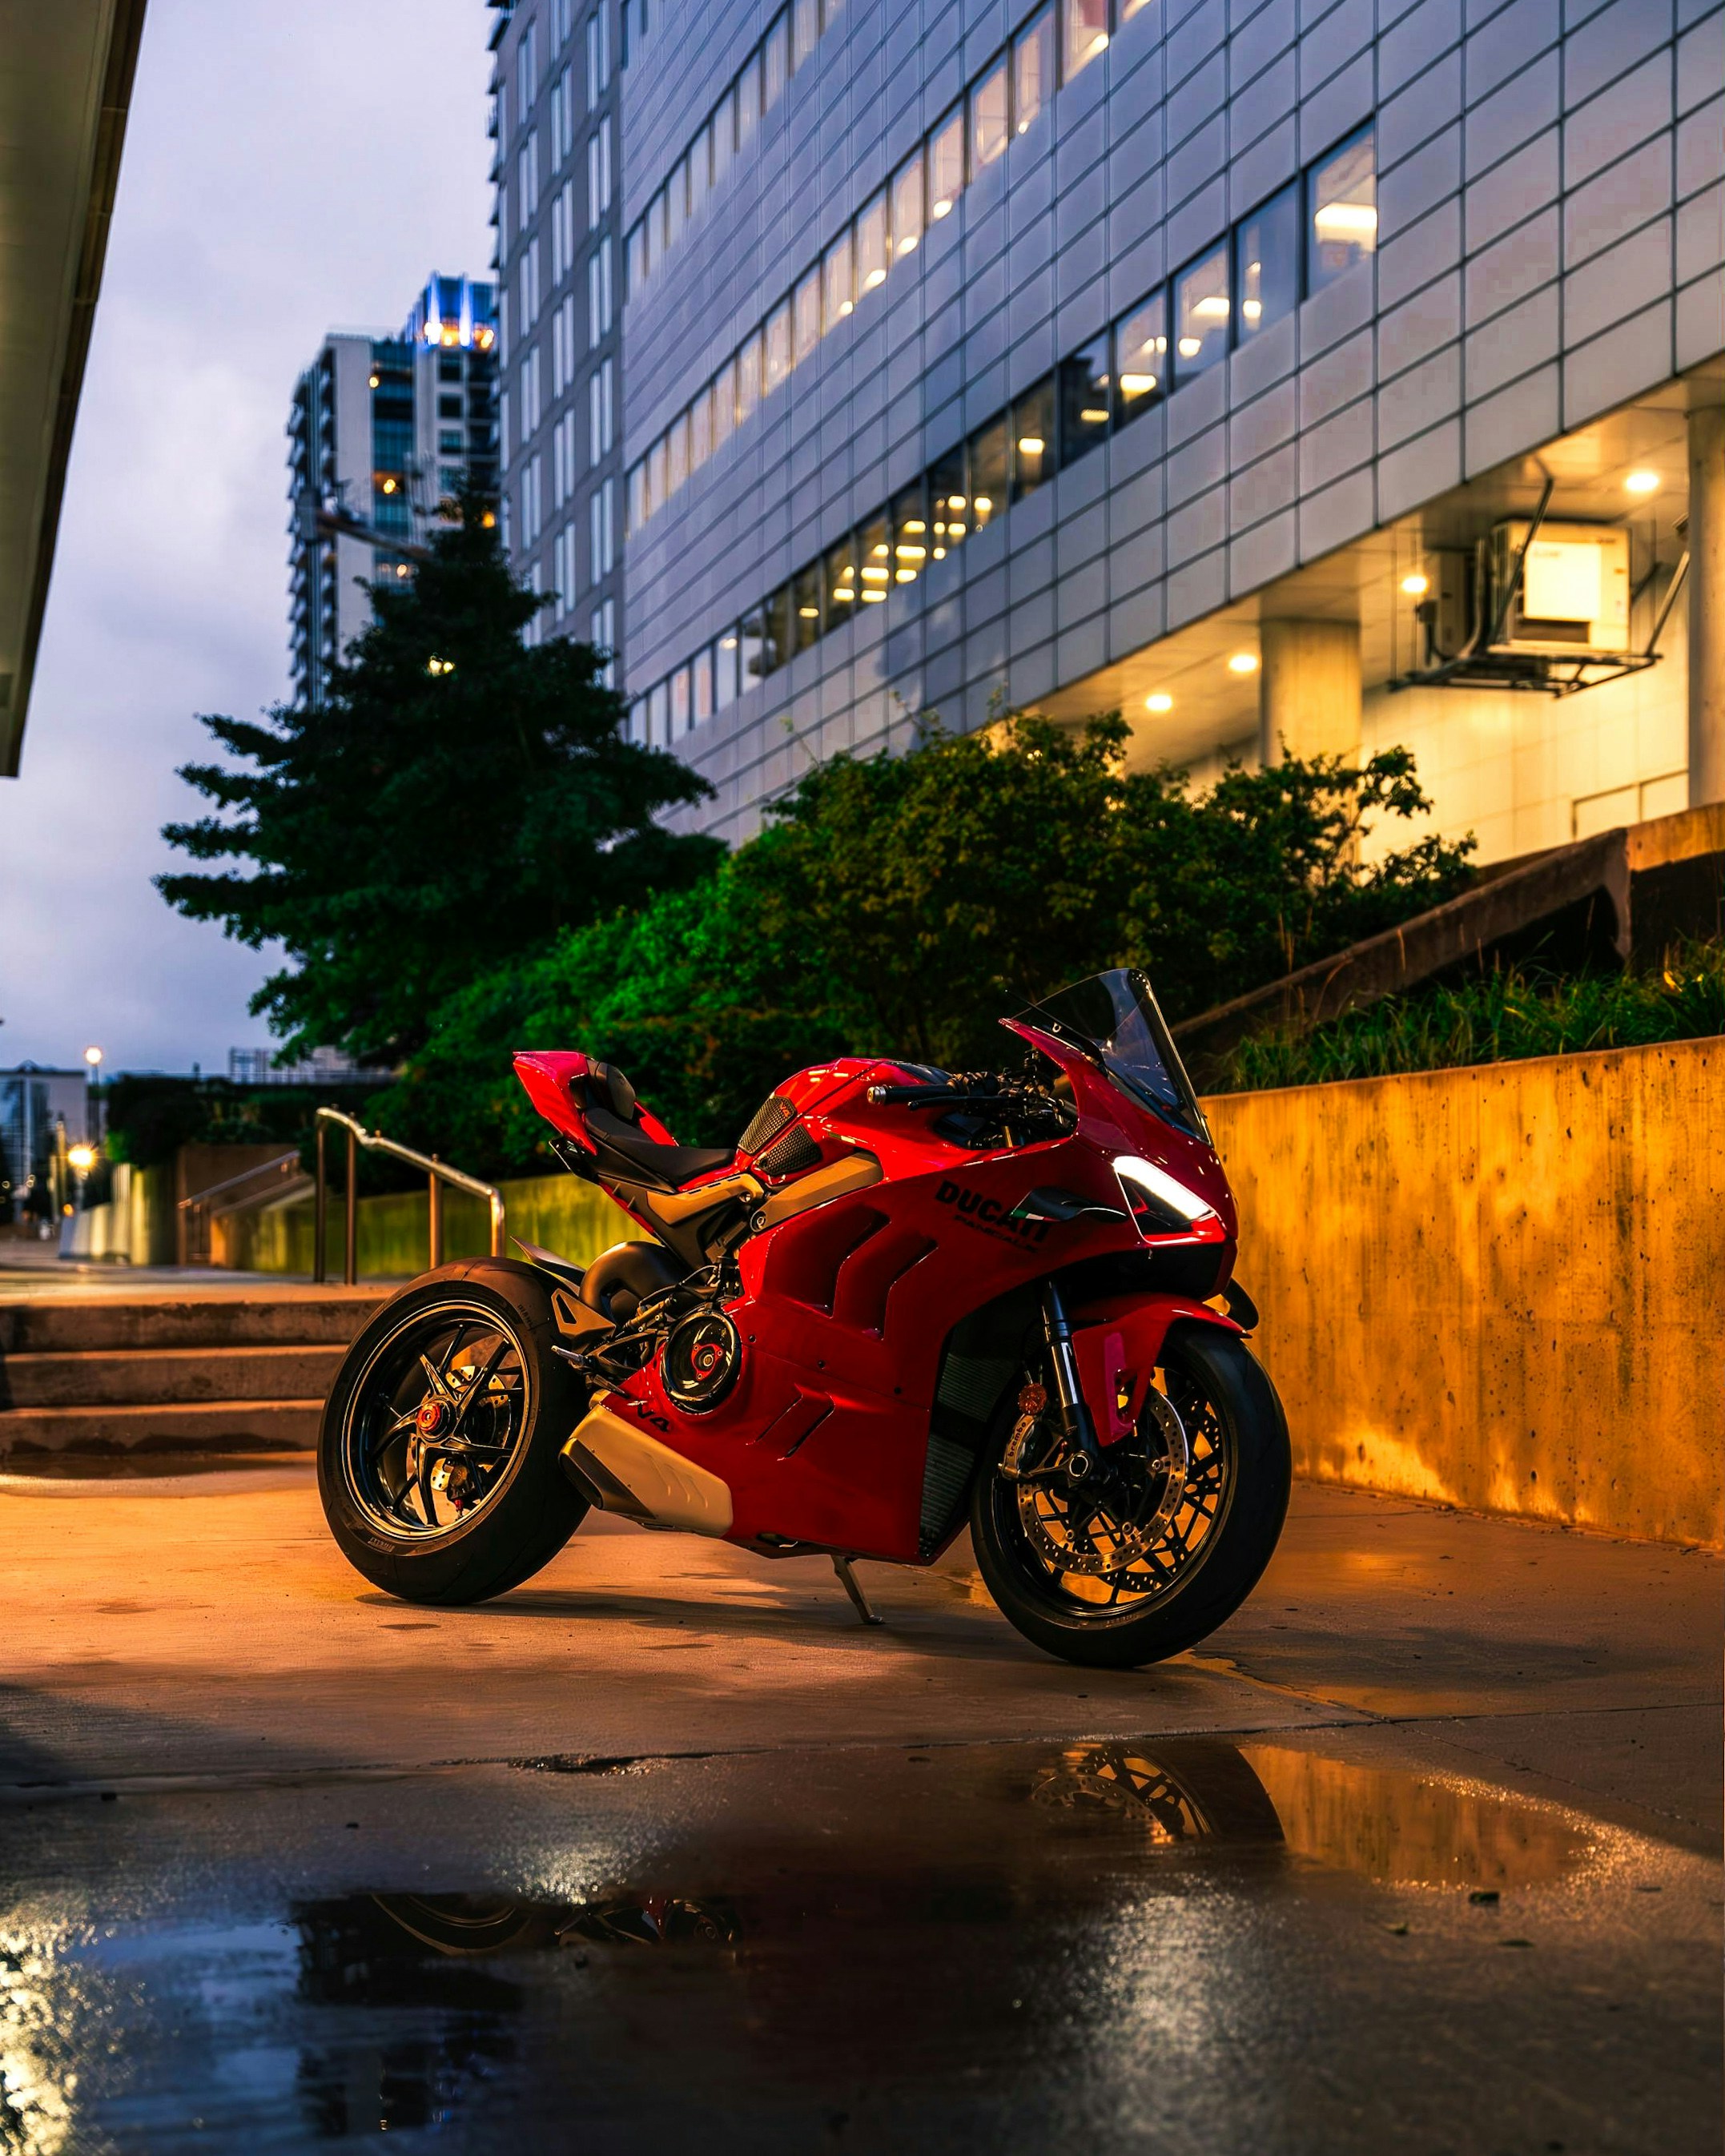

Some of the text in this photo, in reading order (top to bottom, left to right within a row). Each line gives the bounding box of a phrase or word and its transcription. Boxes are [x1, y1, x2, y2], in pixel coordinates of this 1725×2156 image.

[935, 1180, 1051, 1241] DUCATI
[637, 1402, 669, 1433] V4
[1007, 1422, 1026, 1456] brembo
